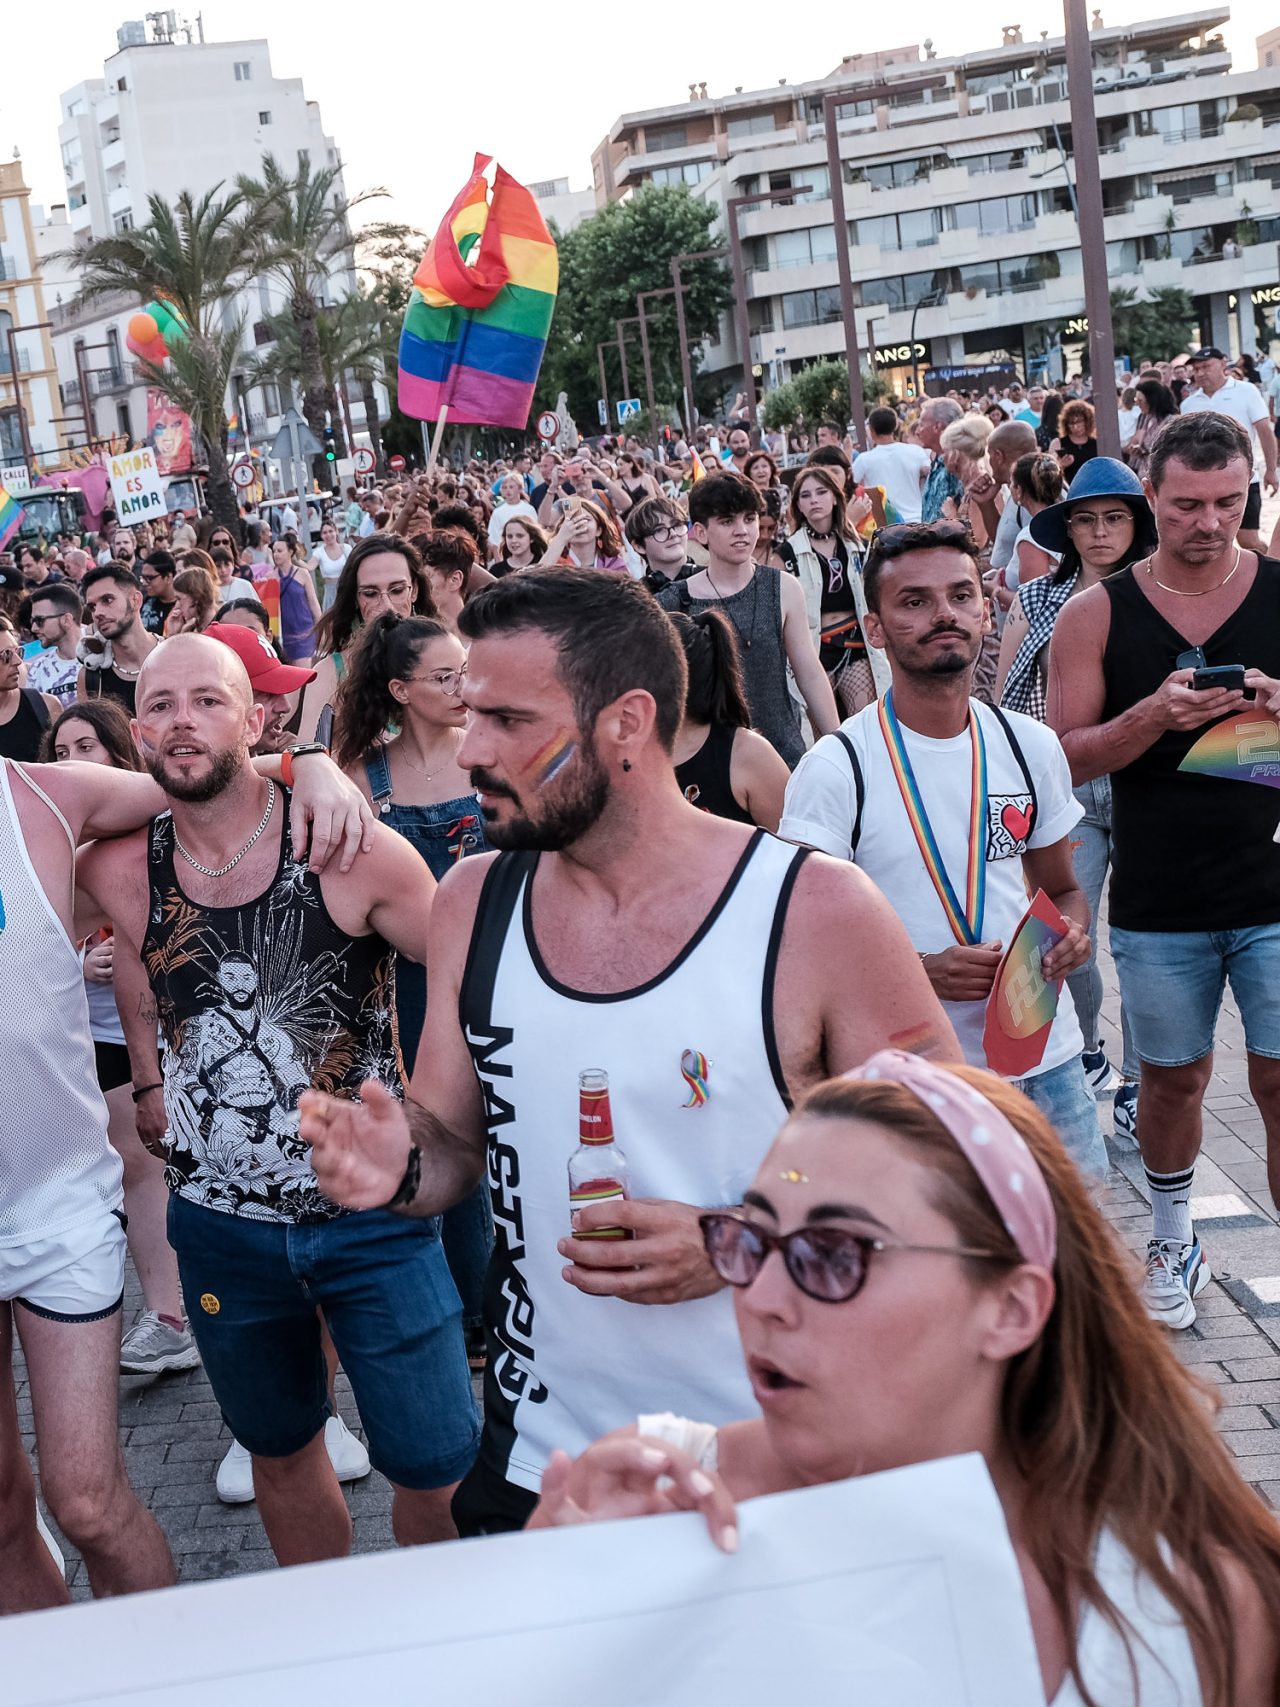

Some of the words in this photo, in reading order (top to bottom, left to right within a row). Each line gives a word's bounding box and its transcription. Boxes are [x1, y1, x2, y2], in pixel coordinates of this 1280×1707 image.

[112, 452, 152, 479] AMOR
[127, 477, 143, 493] ES
[121, 492, 161, 515] AMOR
[1250, 763, 1280, 778] PR
